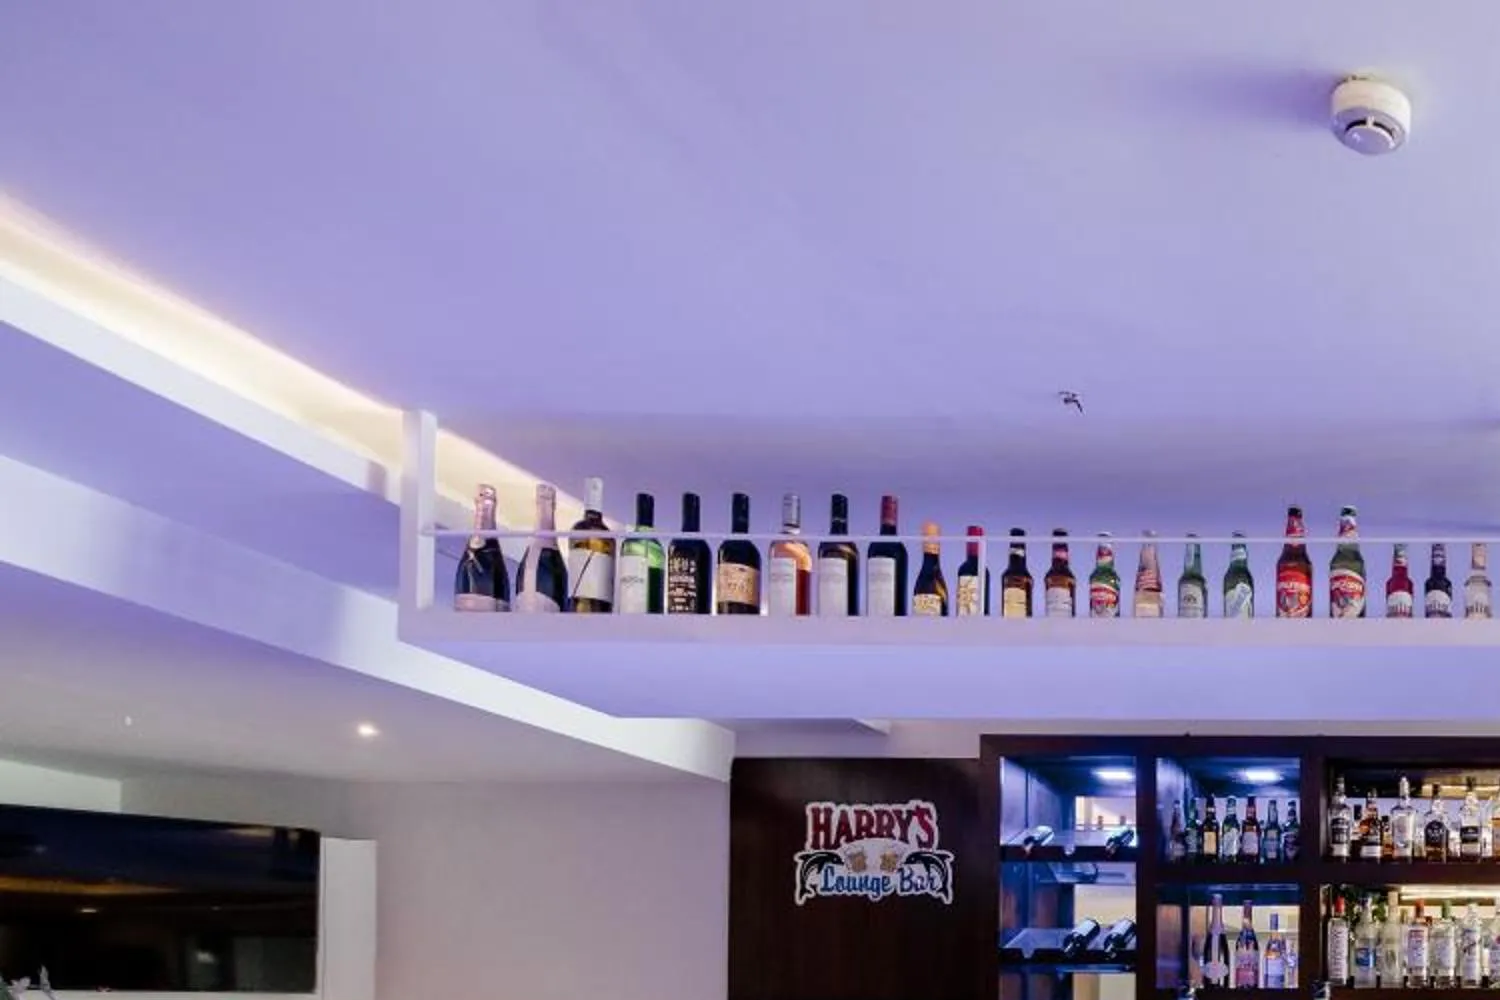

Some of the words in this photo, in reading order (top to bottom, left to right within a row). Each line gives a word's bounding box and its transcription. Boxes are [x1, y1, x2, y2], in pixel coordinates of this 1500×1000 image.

[810, 805, 934, 850] HARRY'S
[820, 865, 893, 896] Lounge
[897, 867, 938, 893] Bar
